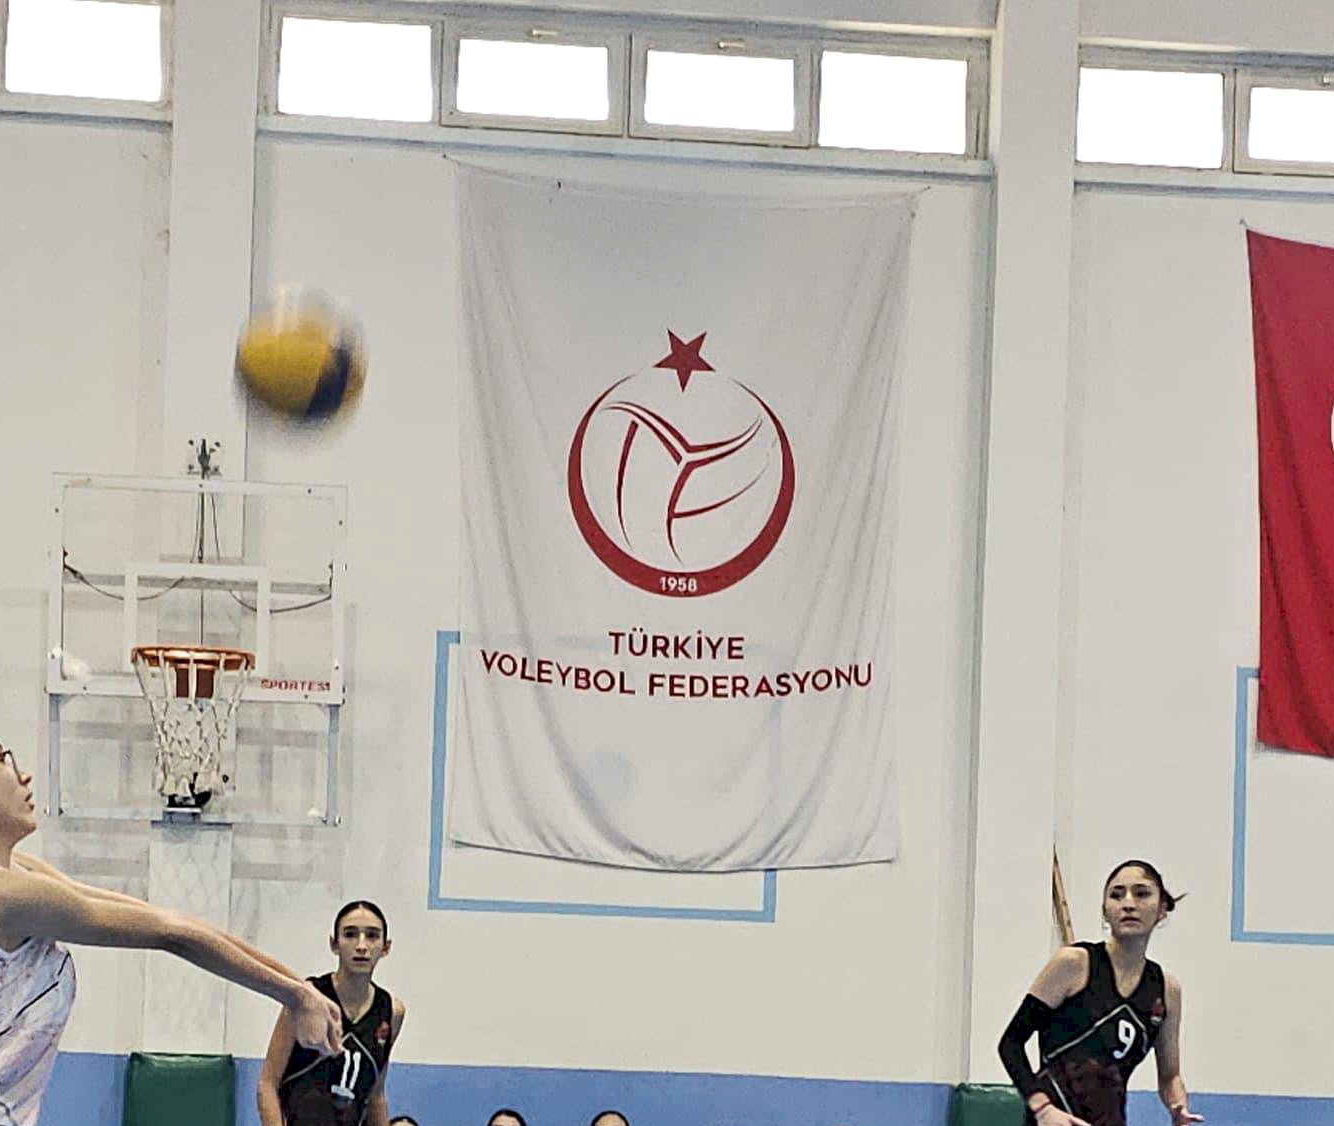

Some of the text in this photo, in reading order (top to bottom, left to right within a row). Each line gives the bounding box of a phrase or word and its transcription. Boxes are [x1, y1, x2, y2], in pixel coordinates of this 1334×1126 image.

[659, 576, 698, 593] 1958
[609, 627, 745, 660] TÜRKİYE
[480, 649, 873, 699] VOLEYBOL FEDERASYONU
[1112, 1019, 1137, 1060] 9
[330, 1049, 362, 1100] 11
